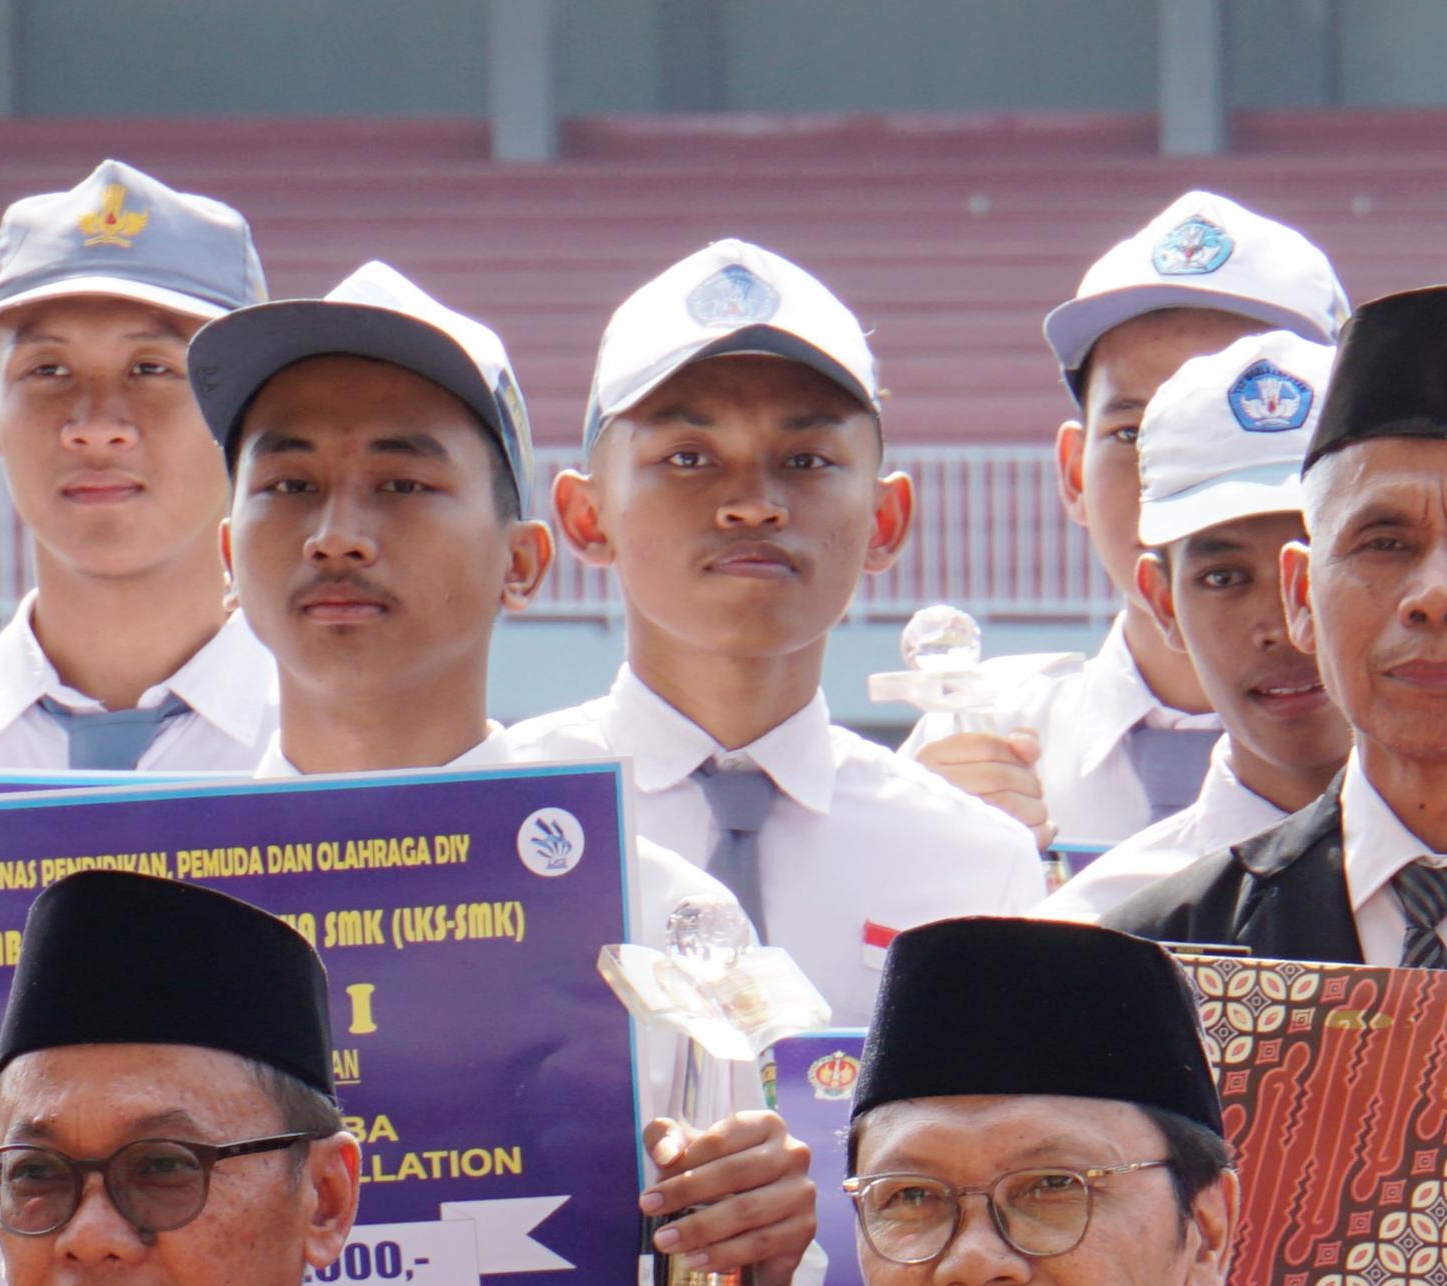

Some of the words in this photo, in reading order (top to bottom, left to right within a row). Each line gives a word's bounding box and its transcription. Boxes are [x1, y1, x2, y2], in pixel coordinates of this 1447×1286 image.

[177, 846, 264, 879] PEMUDA
[267, 844, 313, 875] DAN
[316, 836, 432, 872] OLAHRAGA
[434, 834, 470, 865] DIY
[324, 909, 384, 948] SMK
[392, 901, 526, 949] (LKS-SMK)
[346, 983, 377, 1034] I
